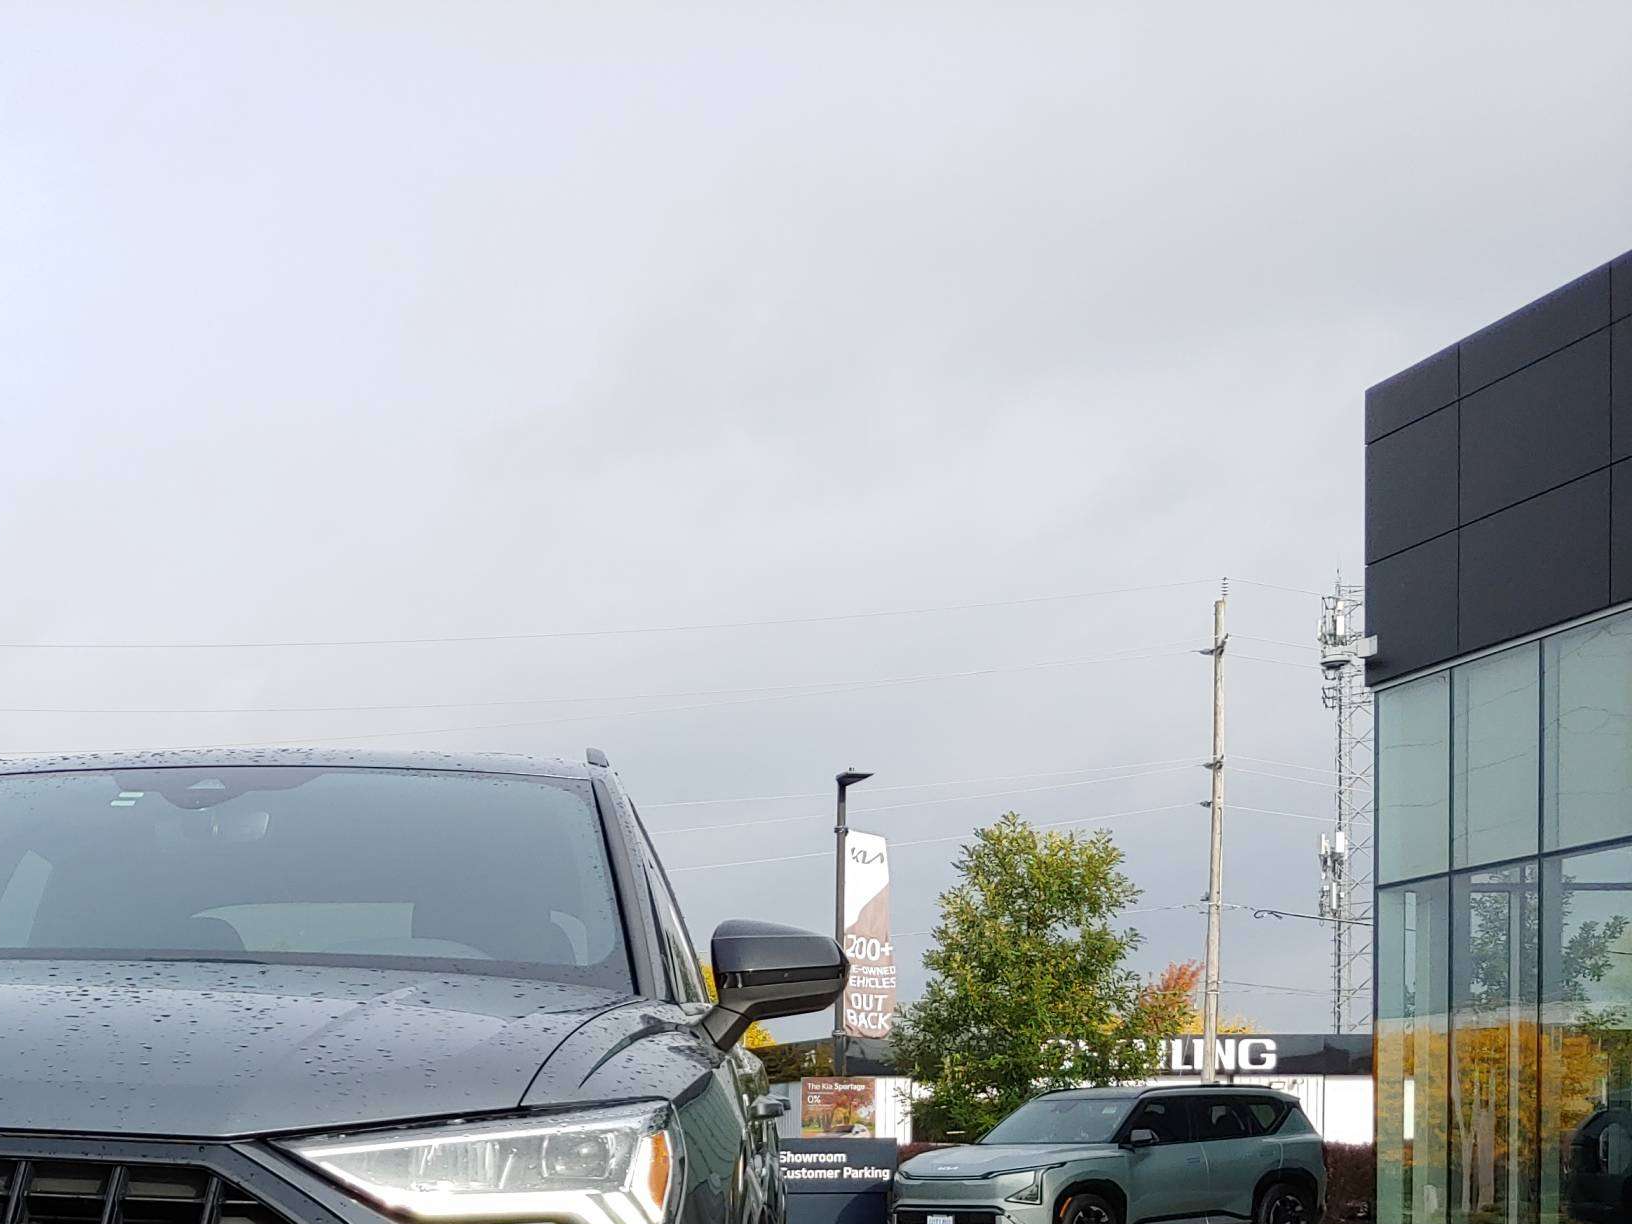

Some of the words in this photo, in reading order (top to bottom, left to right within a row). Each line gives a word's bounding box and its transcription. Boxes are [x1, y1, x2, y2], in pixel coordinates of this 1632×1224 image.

[845, 934, 894, 961] 200+
[848, 975, 897, 989] EHICLES
[851, 992, 889, 1012] OUT
[846, 1008, 893, 1030] BACK
[779, 1150, 847, 1163] Showroom
[843, 1166, 890, 1180] Parking
